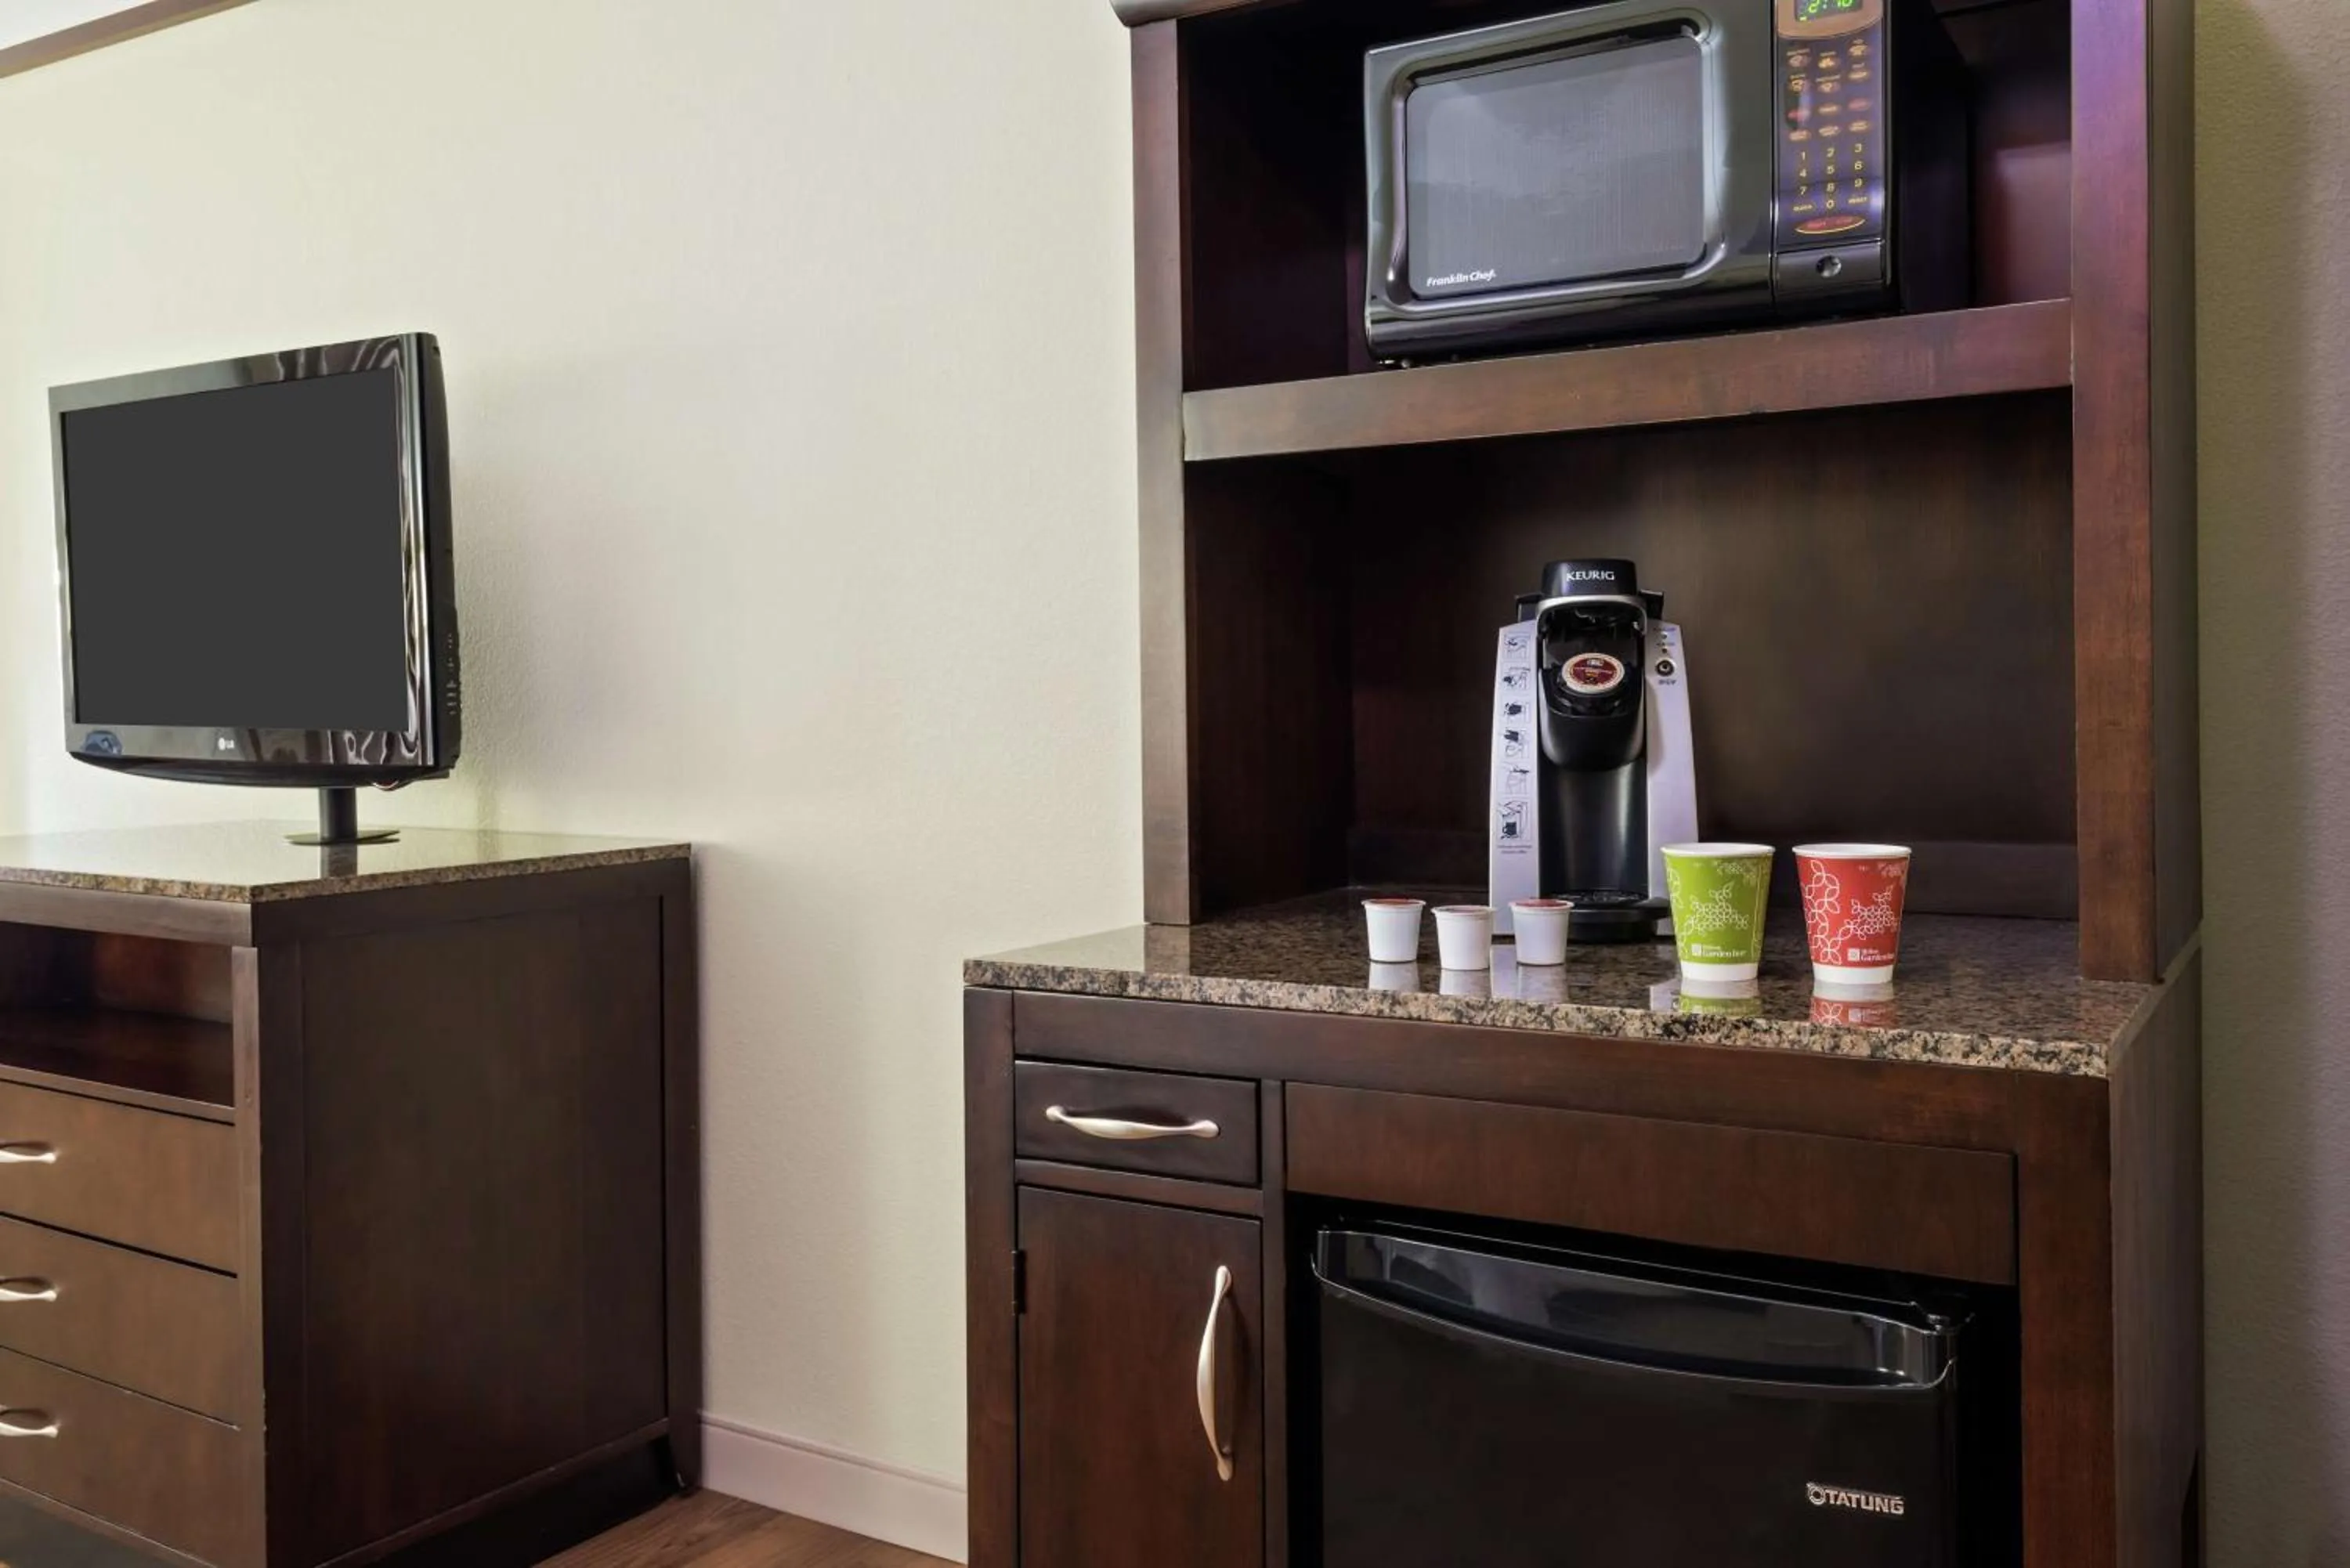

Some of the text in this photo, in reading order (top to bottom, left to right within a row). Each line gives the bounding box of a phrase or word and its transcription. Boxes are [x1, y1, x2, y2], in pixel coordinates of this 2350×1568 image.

[1800, 143, 1862, 161] 1 2 3
[1799, 161, 1863, 178] 4 5 6
[1799, 178, 1862, 195] 7 8 9
[1826, 200, 1835, 209] 0
[1426, 273, 1469, 287] Franklin
[1566, 570, 1615, 581] KEURIG
[1824, 1487, 1905, 1516] TATUNG
